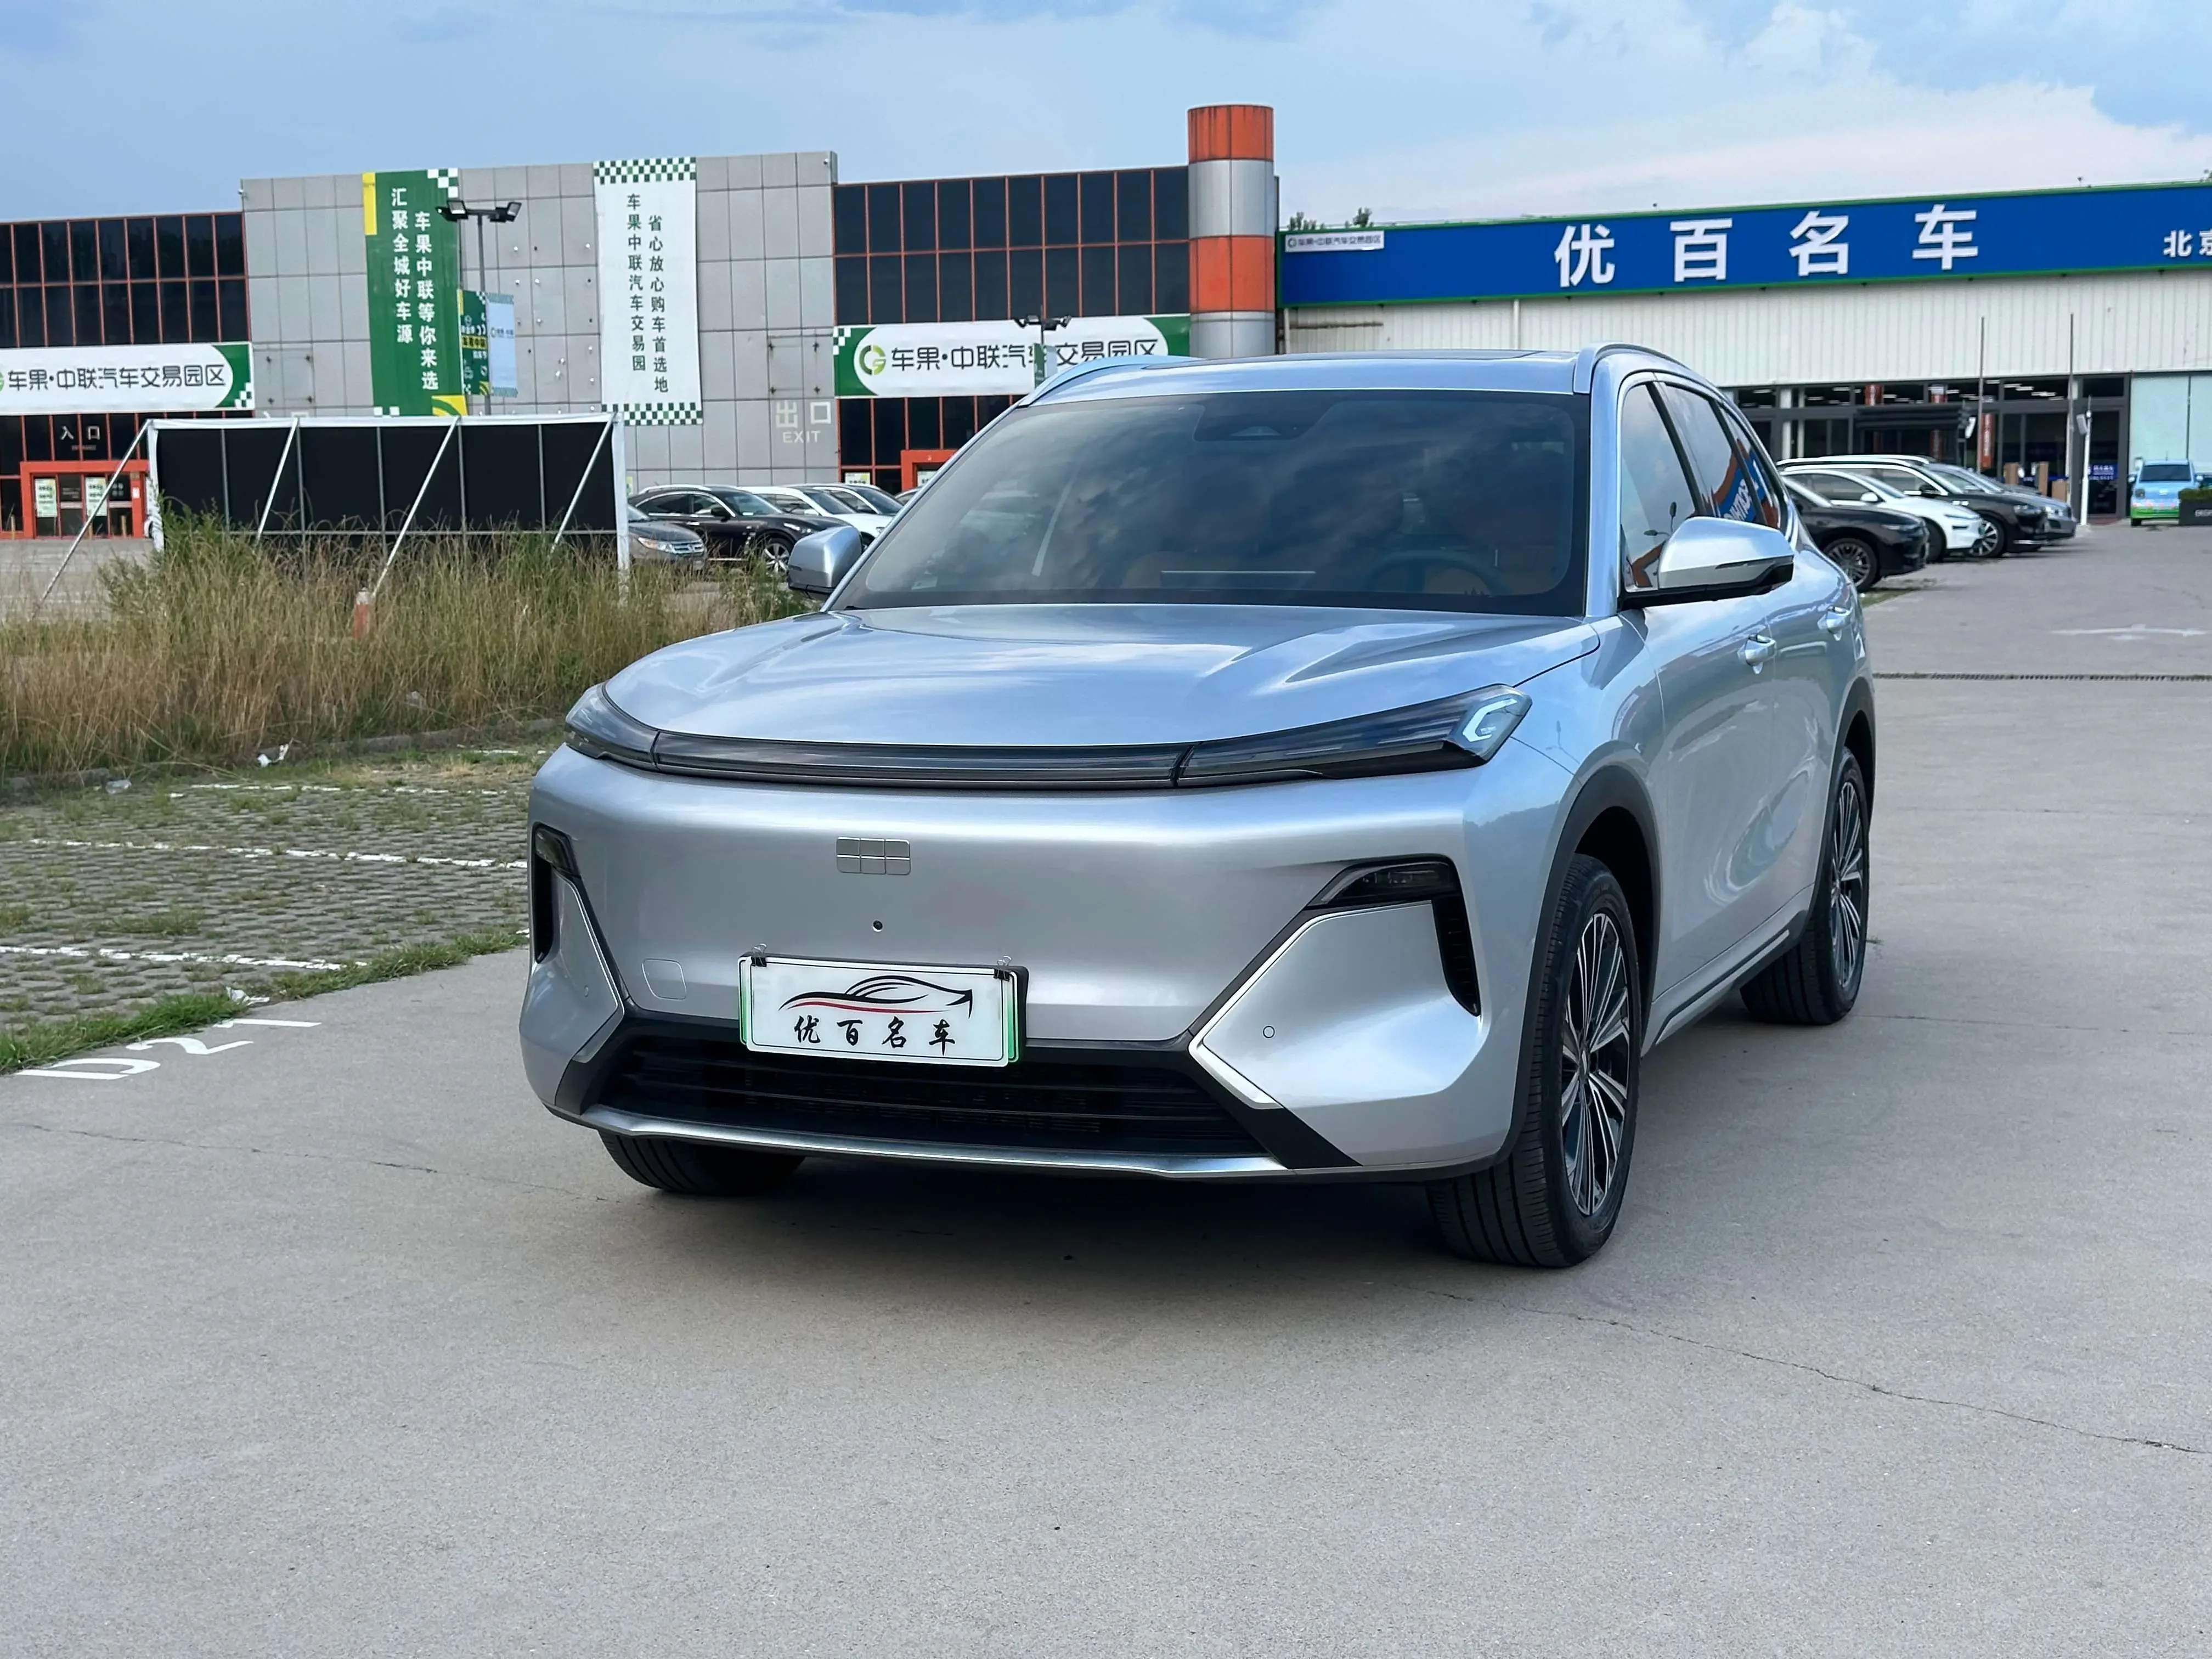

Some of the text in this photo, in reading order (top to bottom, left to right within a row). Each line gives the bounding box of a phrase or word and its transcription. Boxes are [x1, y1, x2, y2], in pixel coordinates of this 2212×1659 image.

[392, 188, 414, 344] 汇聚全城好车源
[1554, 204, 1978, 287] 优百名车
[415, 211, 439, 391] 车果中联等你来选
[627, 194, 646, 371] 车果中联汽车交易园
[648, 215, 669, 393] 省心放心购车首选地
[891, 339, 1158, 371] 车果·中联汽交易园区
[8, 364, 227, 391] 车果·中联汽车交易园区
[61, 425, 100, 441] 入口
[775, 400, 832, 429] 出口
[782, 430, 821, 443] EXIT
[793, 1015, 956, 1056] 优百名车
